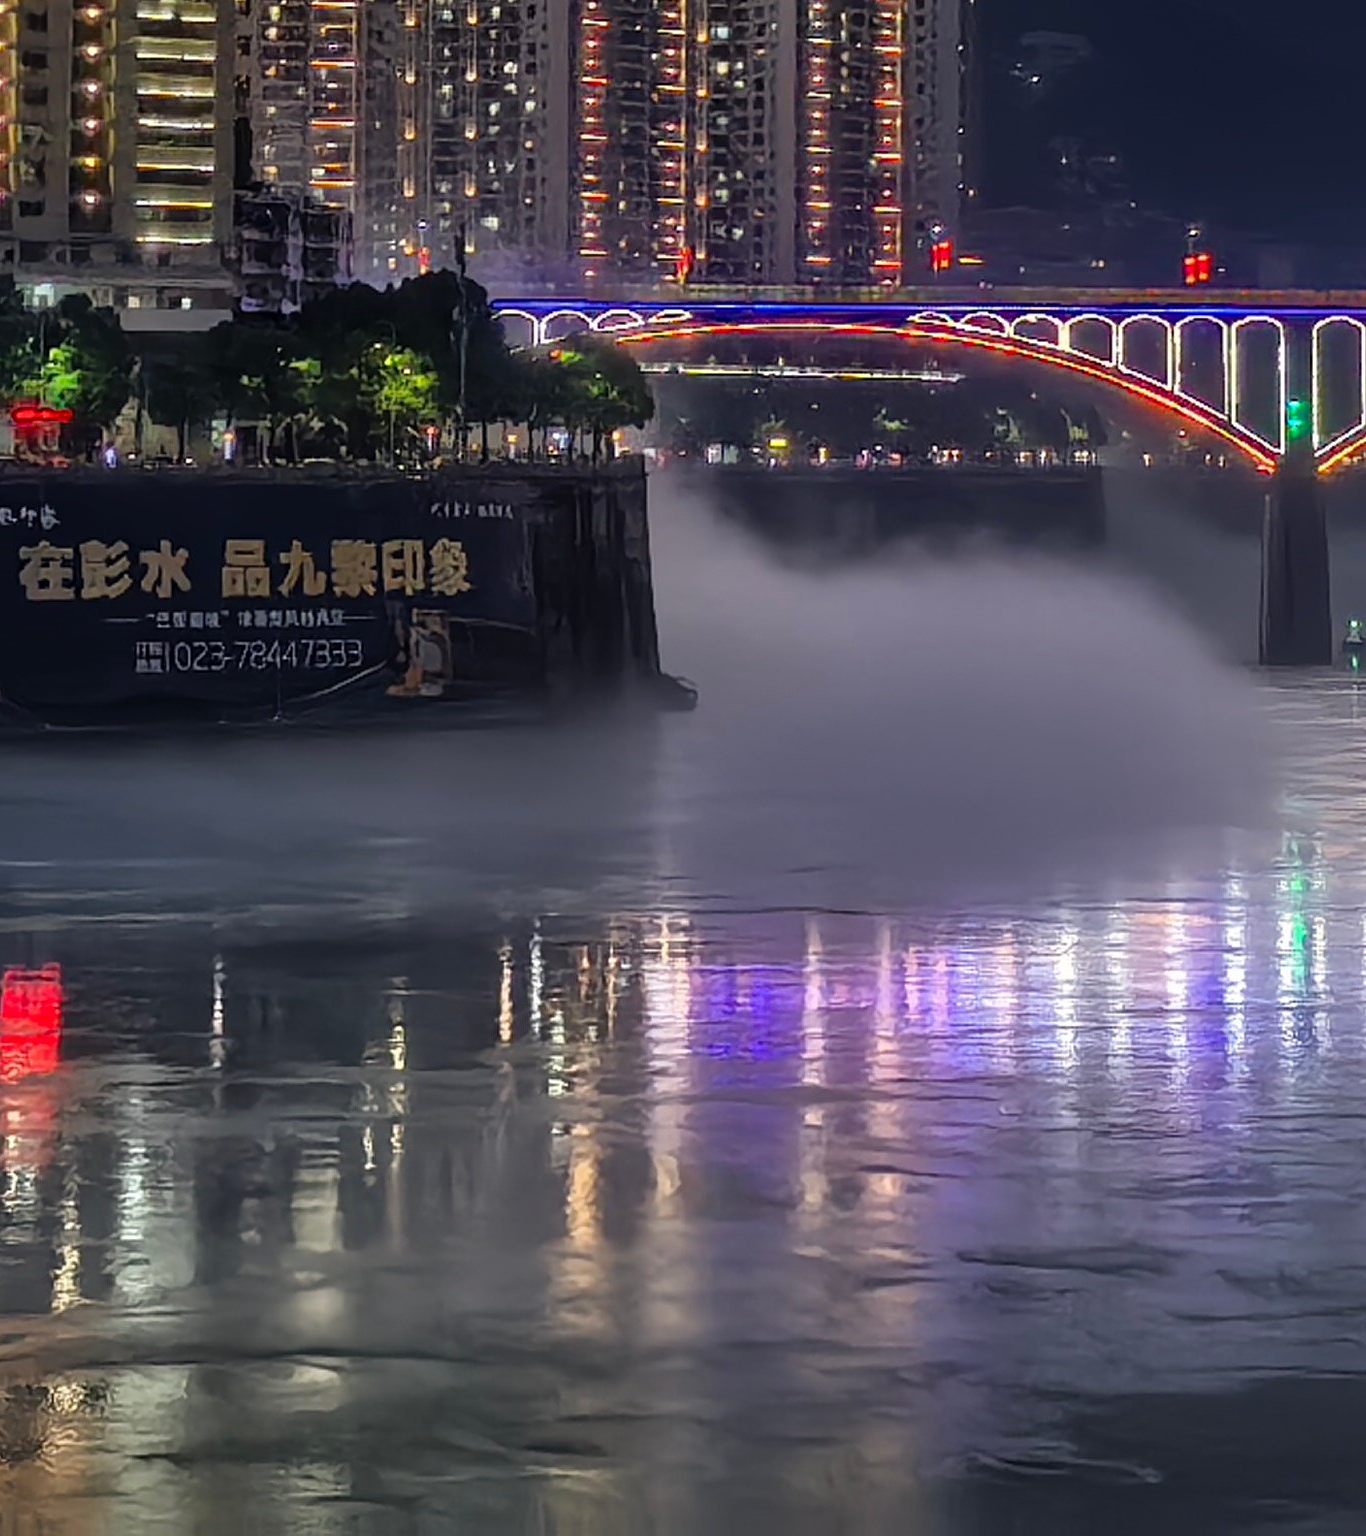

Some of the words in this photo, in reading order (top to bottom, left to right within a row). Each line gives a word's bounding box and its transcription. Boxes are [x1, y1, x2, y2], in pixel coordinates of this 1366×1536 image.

[18, 539, 192, 601] 在彭水
[221, 537, 476, 599] 品九黎印象
